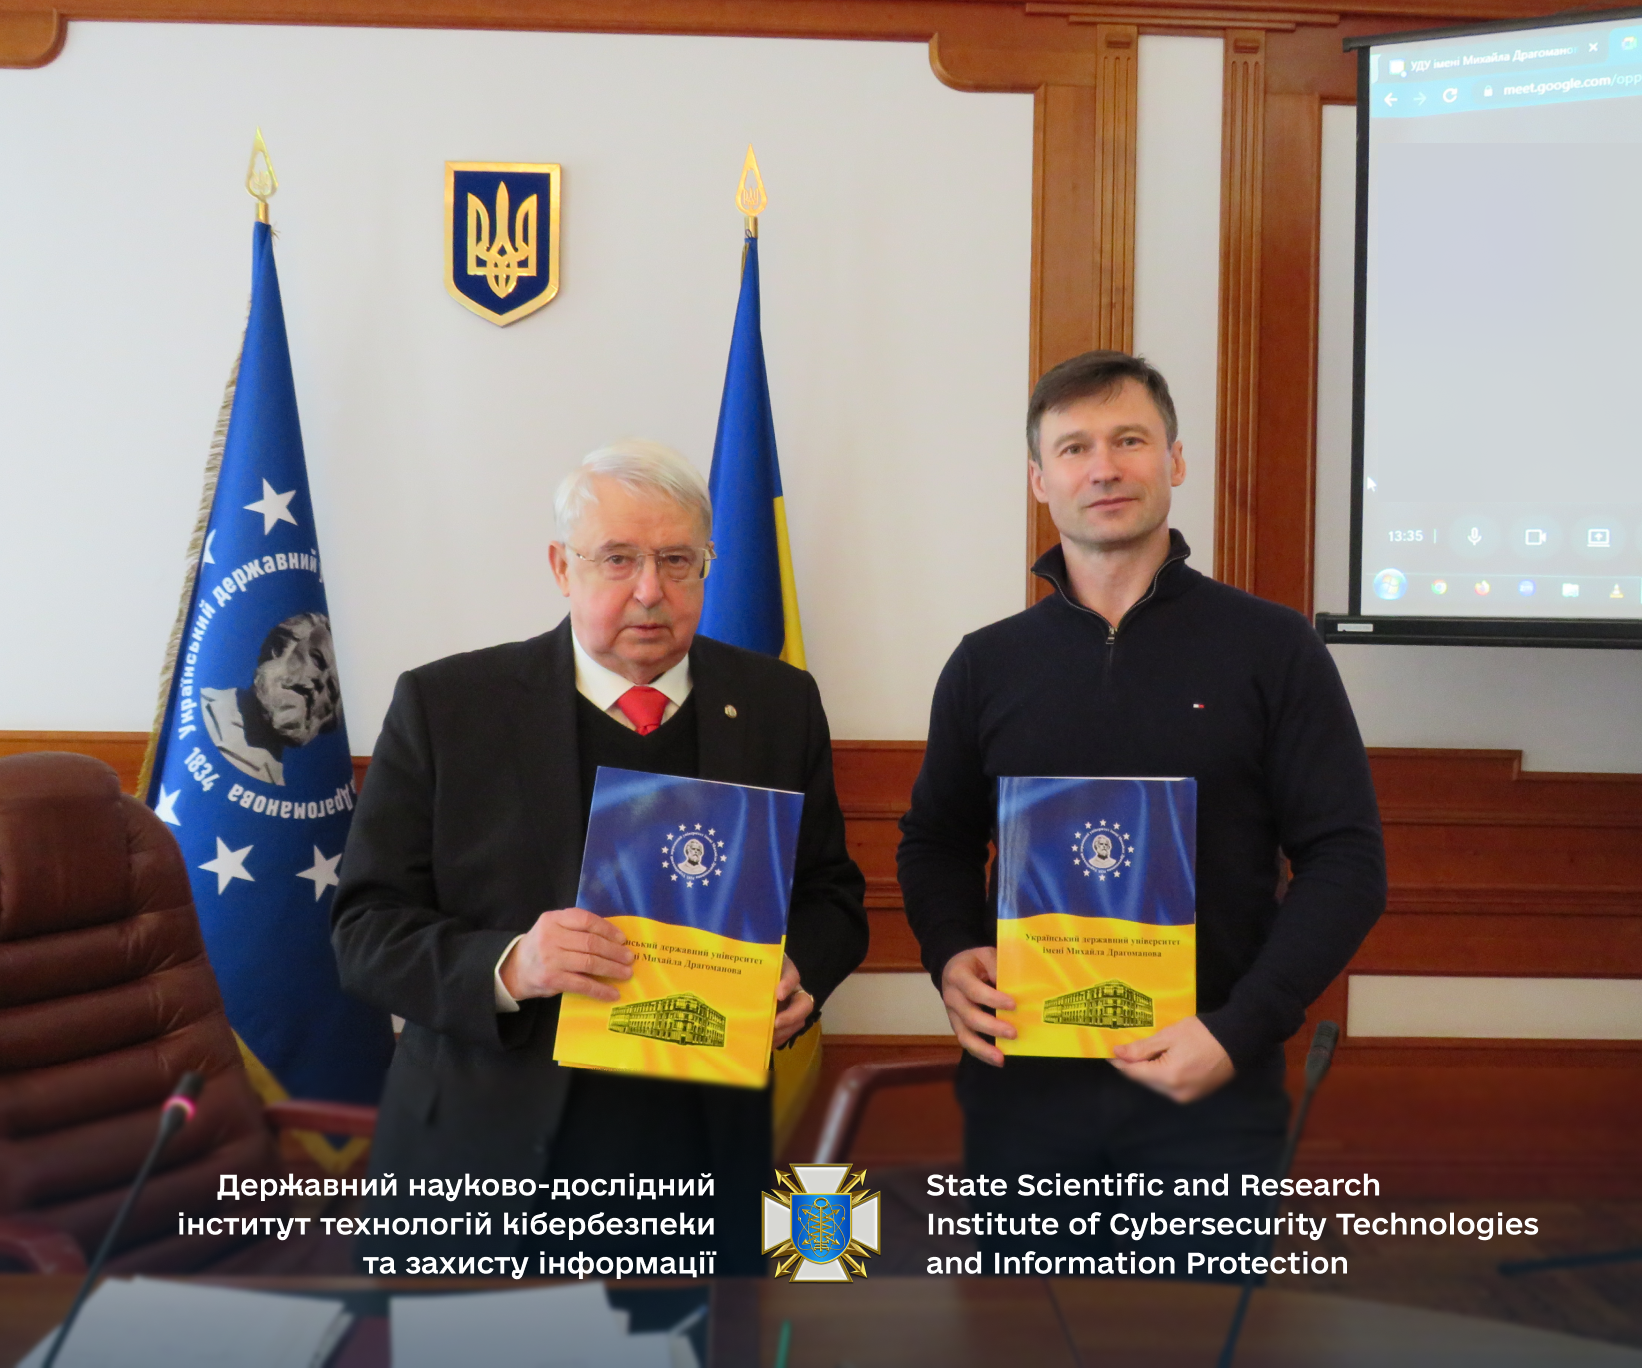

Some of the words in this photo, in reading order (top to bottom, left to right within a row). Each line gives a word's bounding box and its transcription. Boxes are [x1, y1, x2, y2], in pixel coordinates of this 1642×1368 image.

[1410, 59, 1432, 72] УДУ
[1433, 57, 1460, 69] імені
[1463, 52, 1510, 66] Михайла
[1388, 529, 1424, 542] 13:35
[184, 747, 220, 792] 1834
[212, 548, 317, 608] державний
[227, 783, 353, 819] Драгоманова
[1025, 933, 1080, 943] Український
[1082, 936, 1129, 945] державний
[1130, 937, 1181, 947] університет
[624, 939, 658, 950] нський
[660, 943, 709, 957] державний
[711, 951, 764, 966] університет
[1042, 946, 1064, 955] імені
[1066, 947, 1105, 956] Михайла
[1107, 948, 1162, 958] Драгоманова
[643, 953, 682, 966] Михайла
[684, 959, 742, 975] Драгоманова
